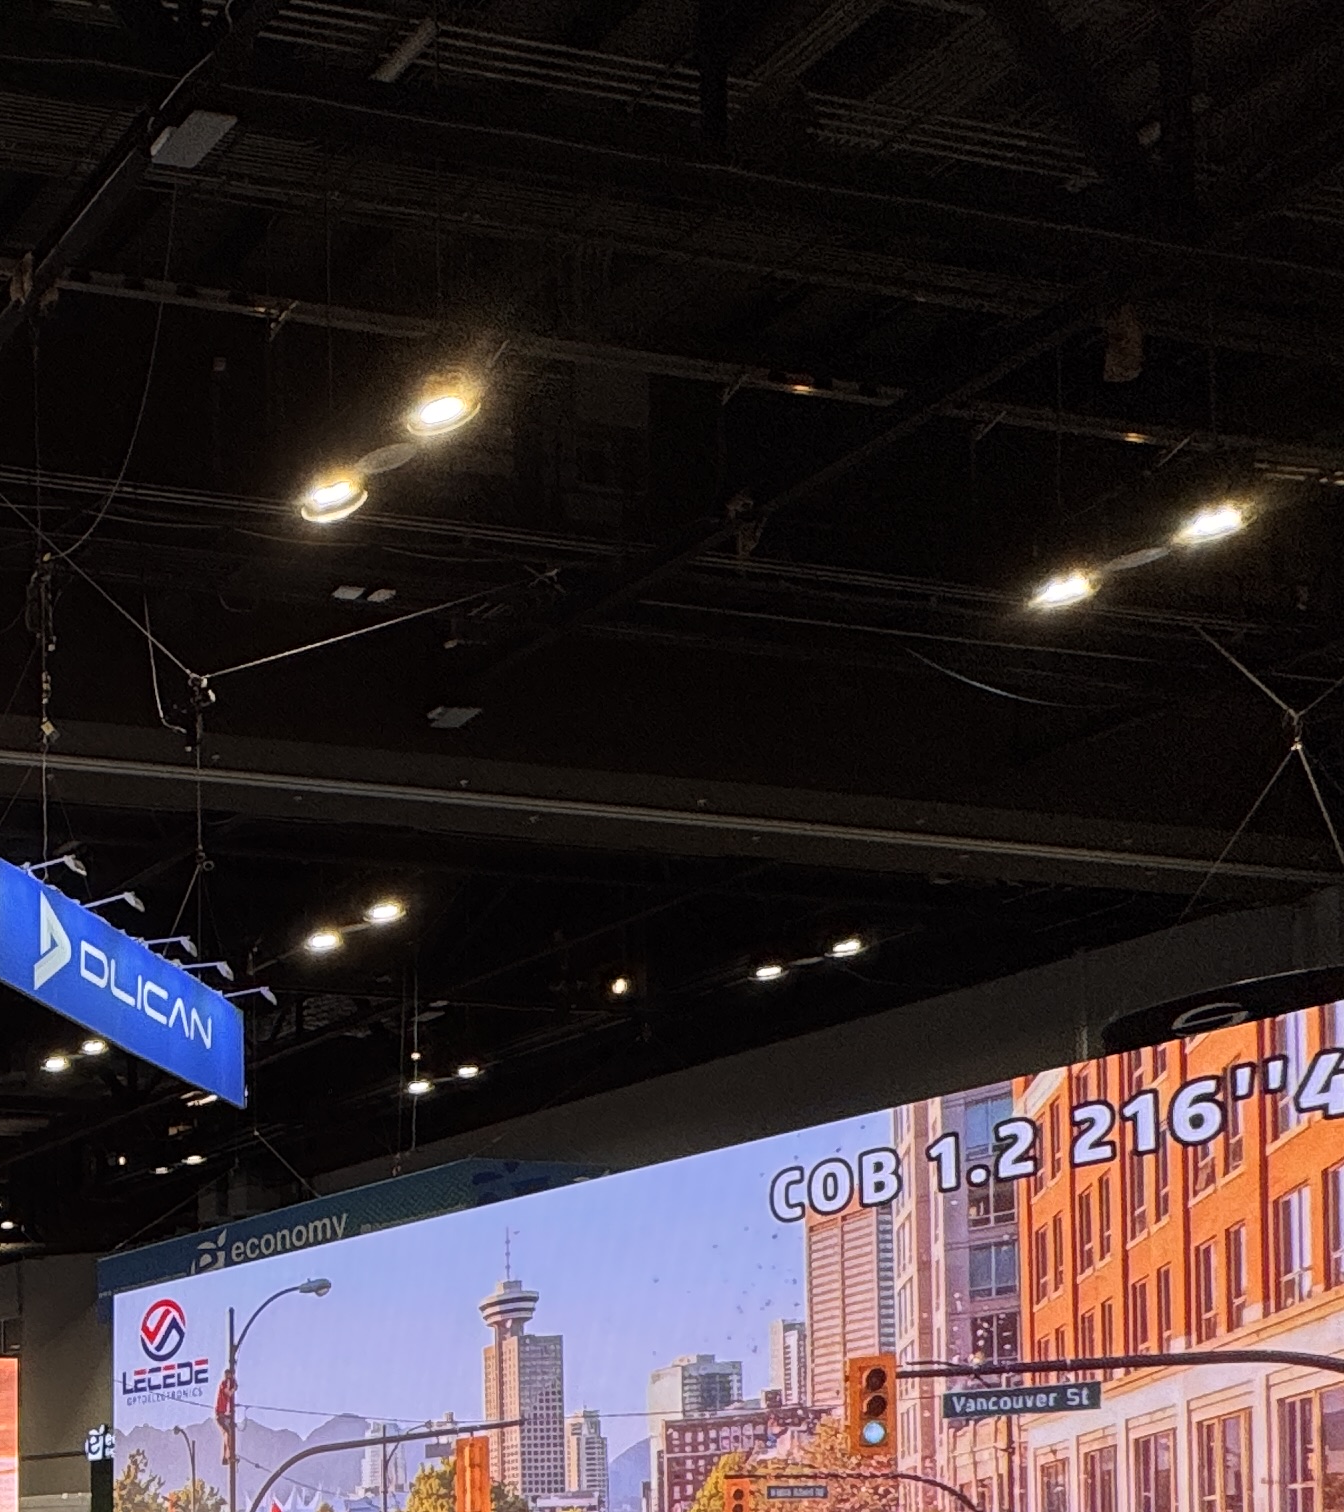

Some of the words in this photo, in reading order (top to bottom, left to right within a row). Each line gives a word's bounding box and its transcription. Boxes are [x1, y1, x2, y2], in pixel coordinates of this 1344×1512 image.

[80, 939, 212, 1050] DLICAN
[769, 1146, 902, 1223] COB
[925, 1117, 1040, 1193] 1.2
[230, 1213, 349, 1263] economy
[122, 1358, 209, 1396] LECEDE
[952, 1392, 1058, 1414] Vancouver
[1066, 1386, 1090, 1406] St
